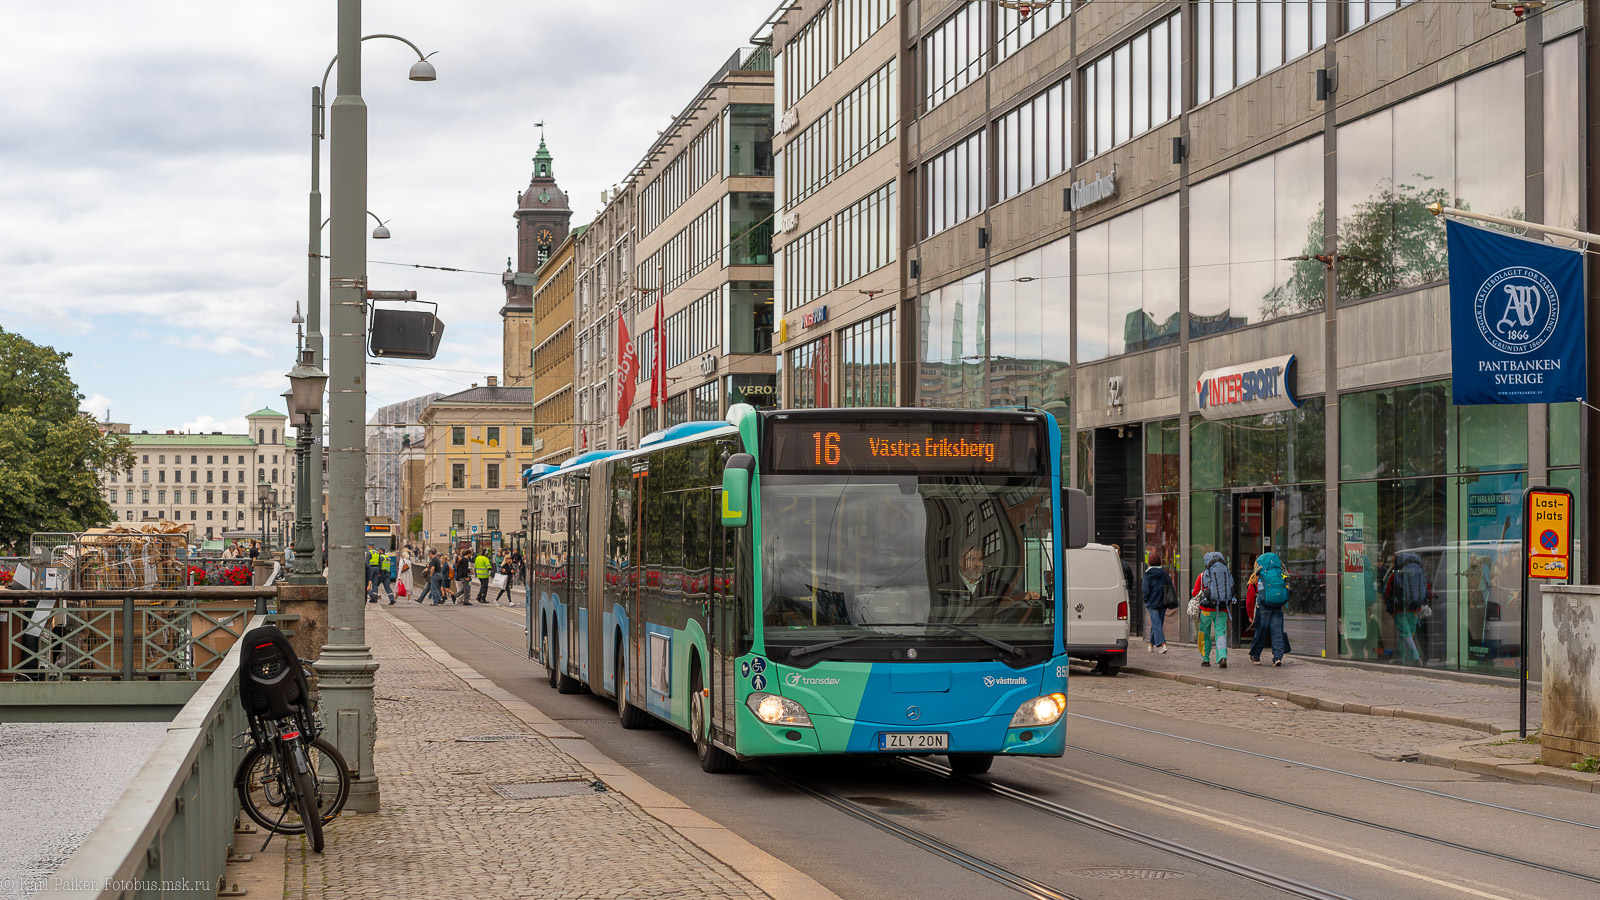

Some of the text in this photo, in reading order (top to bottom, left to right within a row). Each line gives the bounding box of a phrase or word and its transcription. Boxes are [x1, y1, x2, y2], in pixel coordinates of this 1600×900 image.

[1507, 330, 1530, 341] 1866
[1492, 339, 1528, 352] GRUNDAT
[1478, 358, 1561, 372] PANTBANKEN
[1494, 373, 1544, 385] SVERIGE
[738, 385, 773, 395] VERO
[1107, 375, 1124, 406] 32
[1208, 366, 1281, 407] INTERSPORT
[812, 431, 995, 465] 16 Västra Eriksberg
[1535, 497, 1564, 508] Last-
[1536, 510, 1563, 522] plats
[802, 676, 841, 685] transdev
[995, 676, 1028, 685] västtrafik
[890, 735, 914, 747] ZLY
[918, 735, 943, 747] 20N
